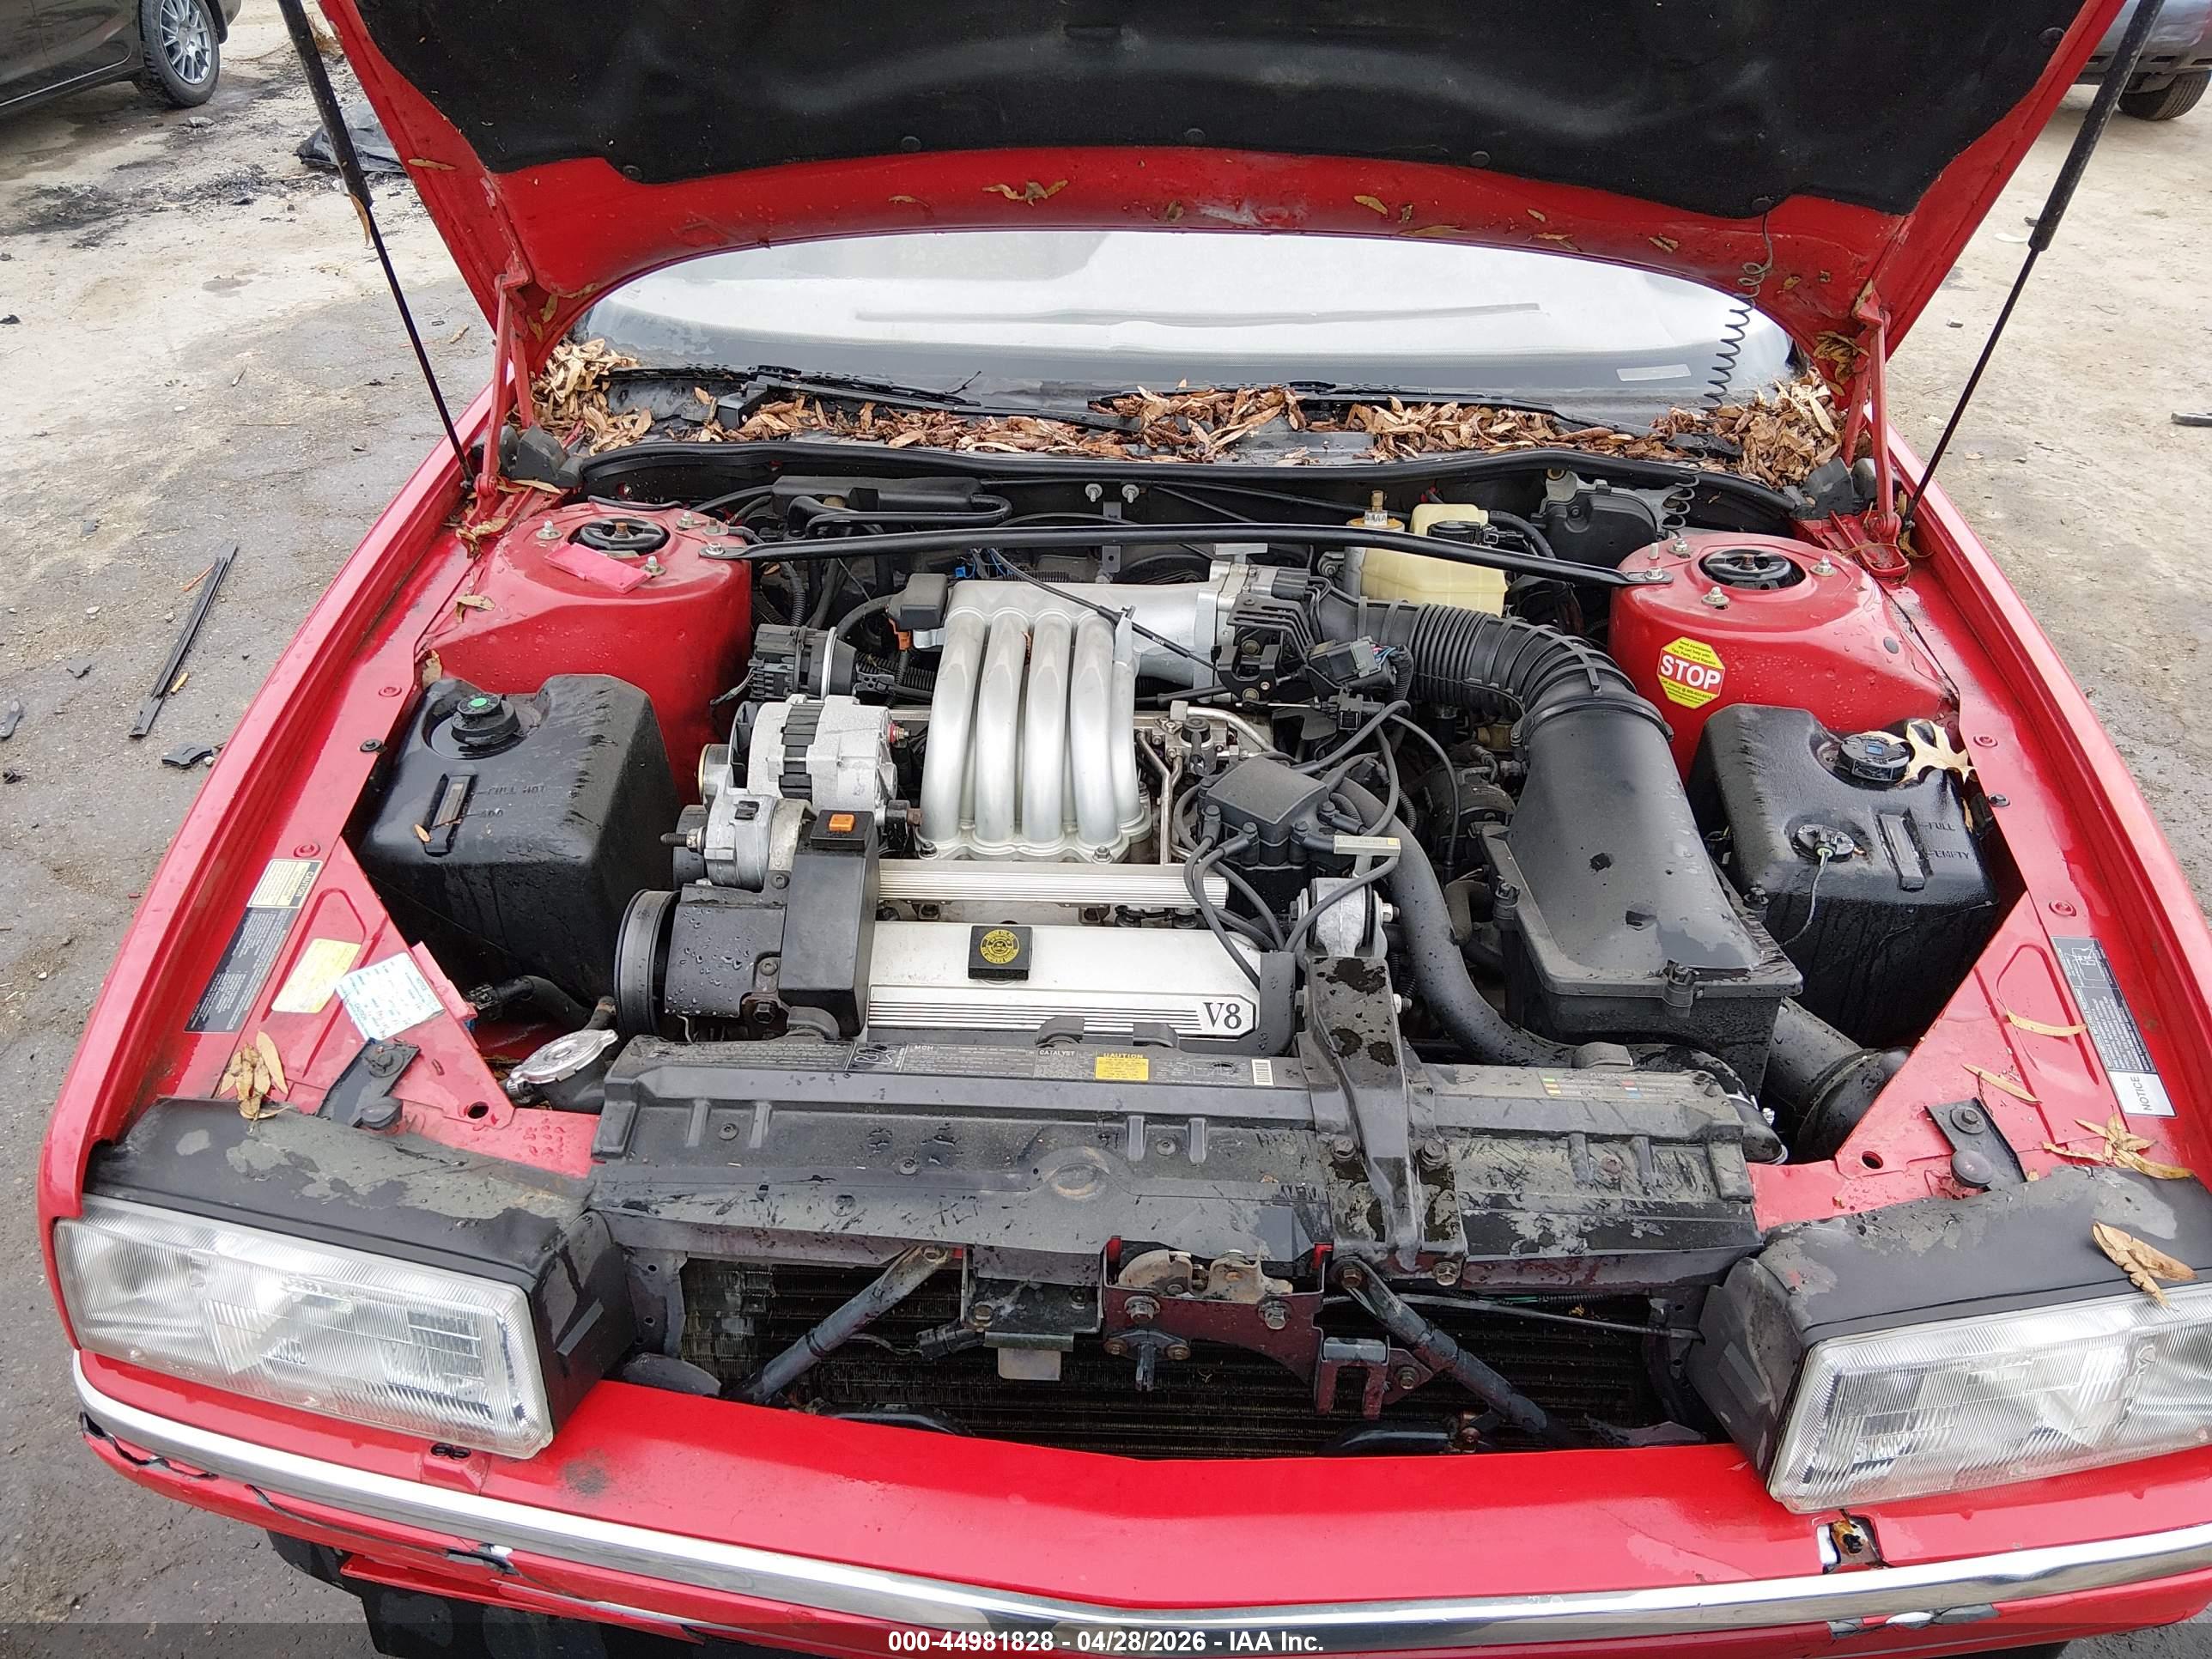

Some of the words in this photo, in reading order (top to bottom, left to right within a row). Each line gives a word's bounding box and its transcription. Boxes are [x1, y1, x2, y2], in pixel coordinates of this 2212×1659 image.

[1661, 655, 1721, 690] STOP
[1929, 822, 1956, 831] FULL
[1934, 849, 1970, 860] EMPTY
[295, 871, 315, 897] CAUTION
[1202, 1001, 1243, 1030] V8
[2130, 1075, 2154, 1113] NOTICE
